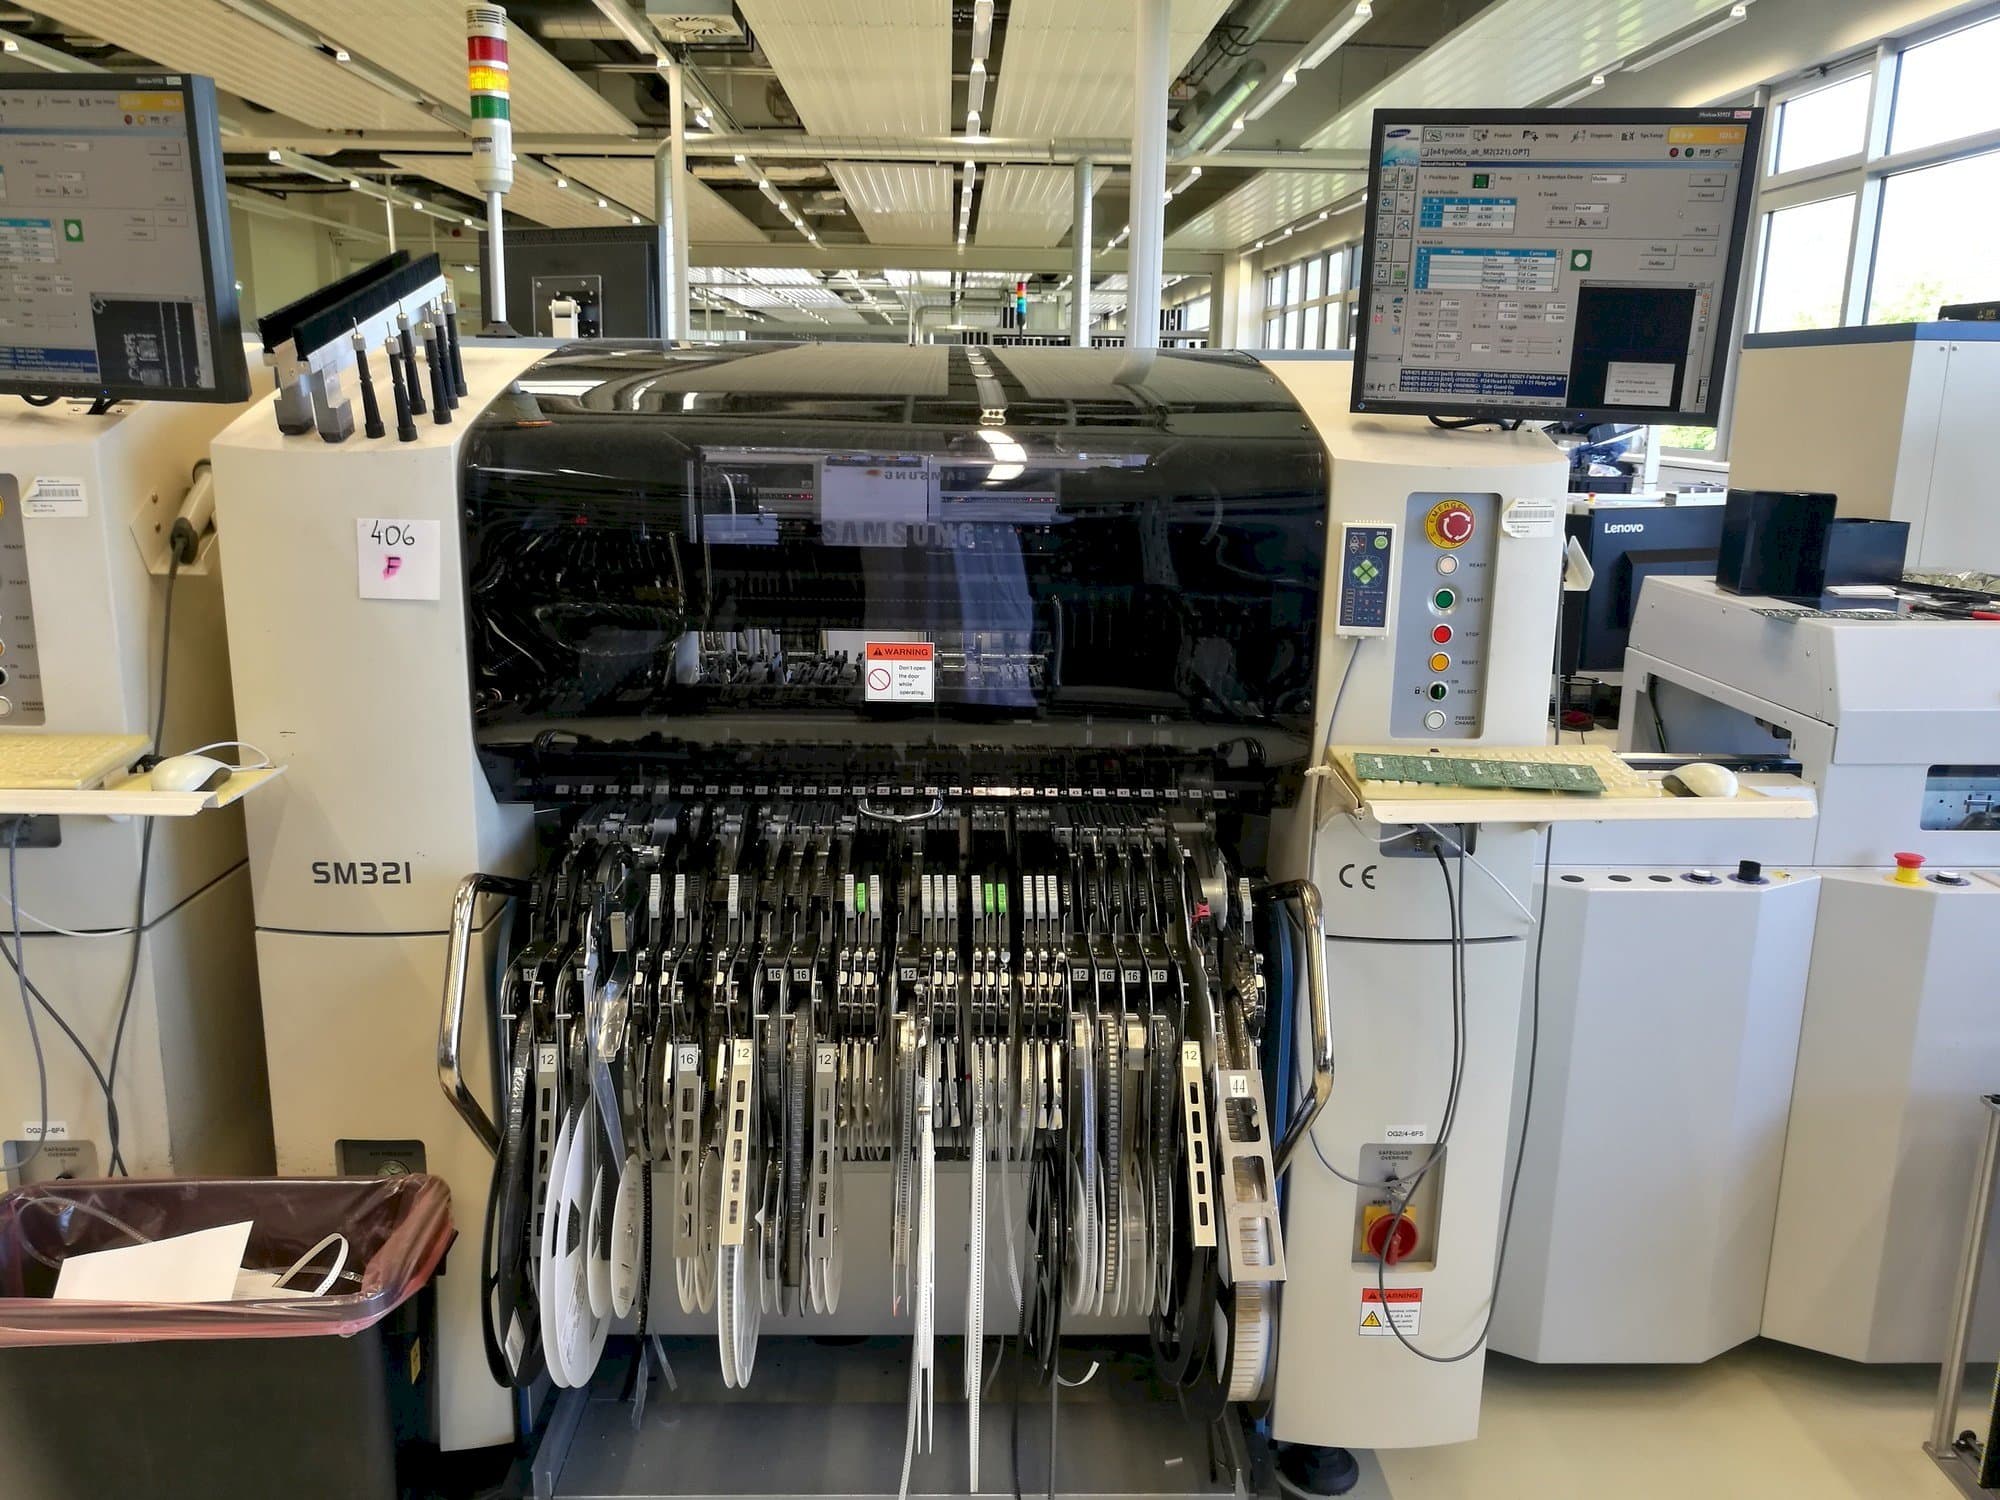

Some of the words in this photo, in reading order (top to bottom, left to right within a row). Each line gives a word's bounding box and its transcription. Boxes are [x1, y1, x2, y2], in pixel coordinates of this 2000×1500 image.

[371, 520, 415, 546] 406
[823, 520, 975, 546] SAMSUNG
[1604, 522, 1644, 534] Lenovo
[885, 648, 928, 656] WARNING
[312, 862, 411, 884] SM321
[1339, 863, 1377, 890] CE
[770, 970, 781, 979] 16
[795, 970, 807, 979] 16
[903, 969, 915, 980] 12
[1074, 969, 1086, 979] 12
[1101, 970, 1113, 981] 16
[1127, 971, 1138, 981] 16
[1153, 970, 1165, 981] 16
[737, 1047, 749, 1058] 12
[1184, 1050, 1197, 1061] 12
[541, 1054, 554, 1065] 12
[680, 1053, 694, 1065] 16
[818, 1054, 831, 1065] 12
[1233, 1078, 1245, 1093] 44
